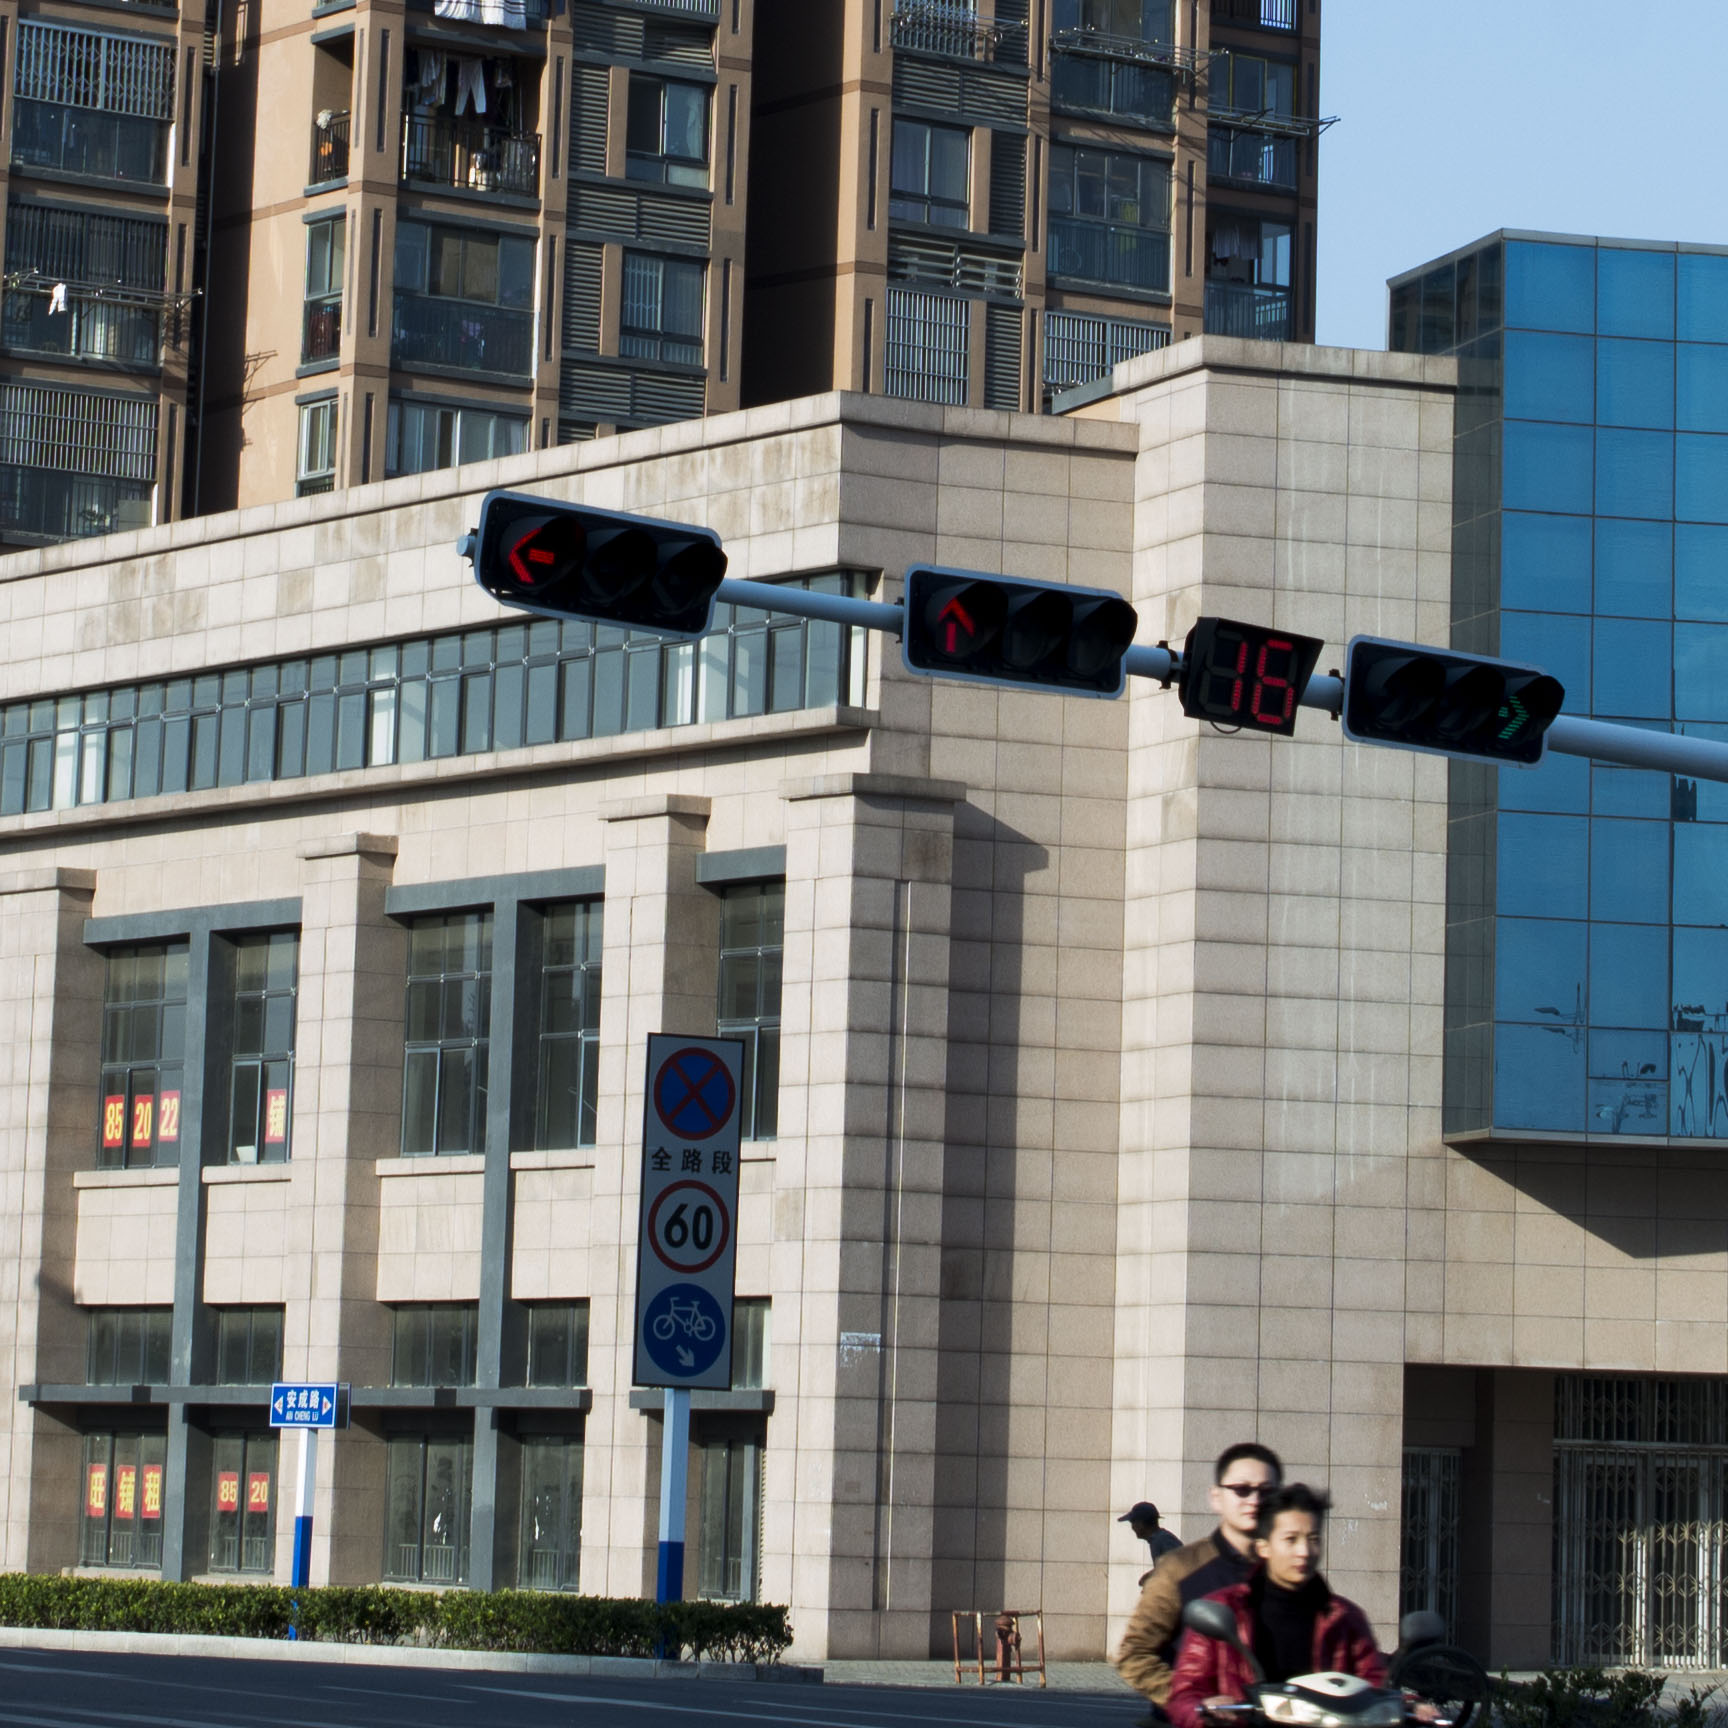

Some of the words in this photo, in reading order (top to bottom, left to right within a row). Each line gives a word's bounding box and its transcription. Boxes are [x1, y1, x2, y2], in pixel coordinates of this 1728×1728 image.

[1231, 639, 1294, 725] 16
[105, 1102, 123, 1140] 85
[133, 1103, 152, 1140] 20
[159, 1098, 179, 1137] 22
[651, 1146, 733, 1176] 全路段
[664, 1203, 713, 1250] 60
[286, 1389, 320, 1409] 安成路
[90, 1471, 161, 1513] 旺铺租
[221, 1480, 238, 1502] 85
[251, 1481, 268, 1503] 20
